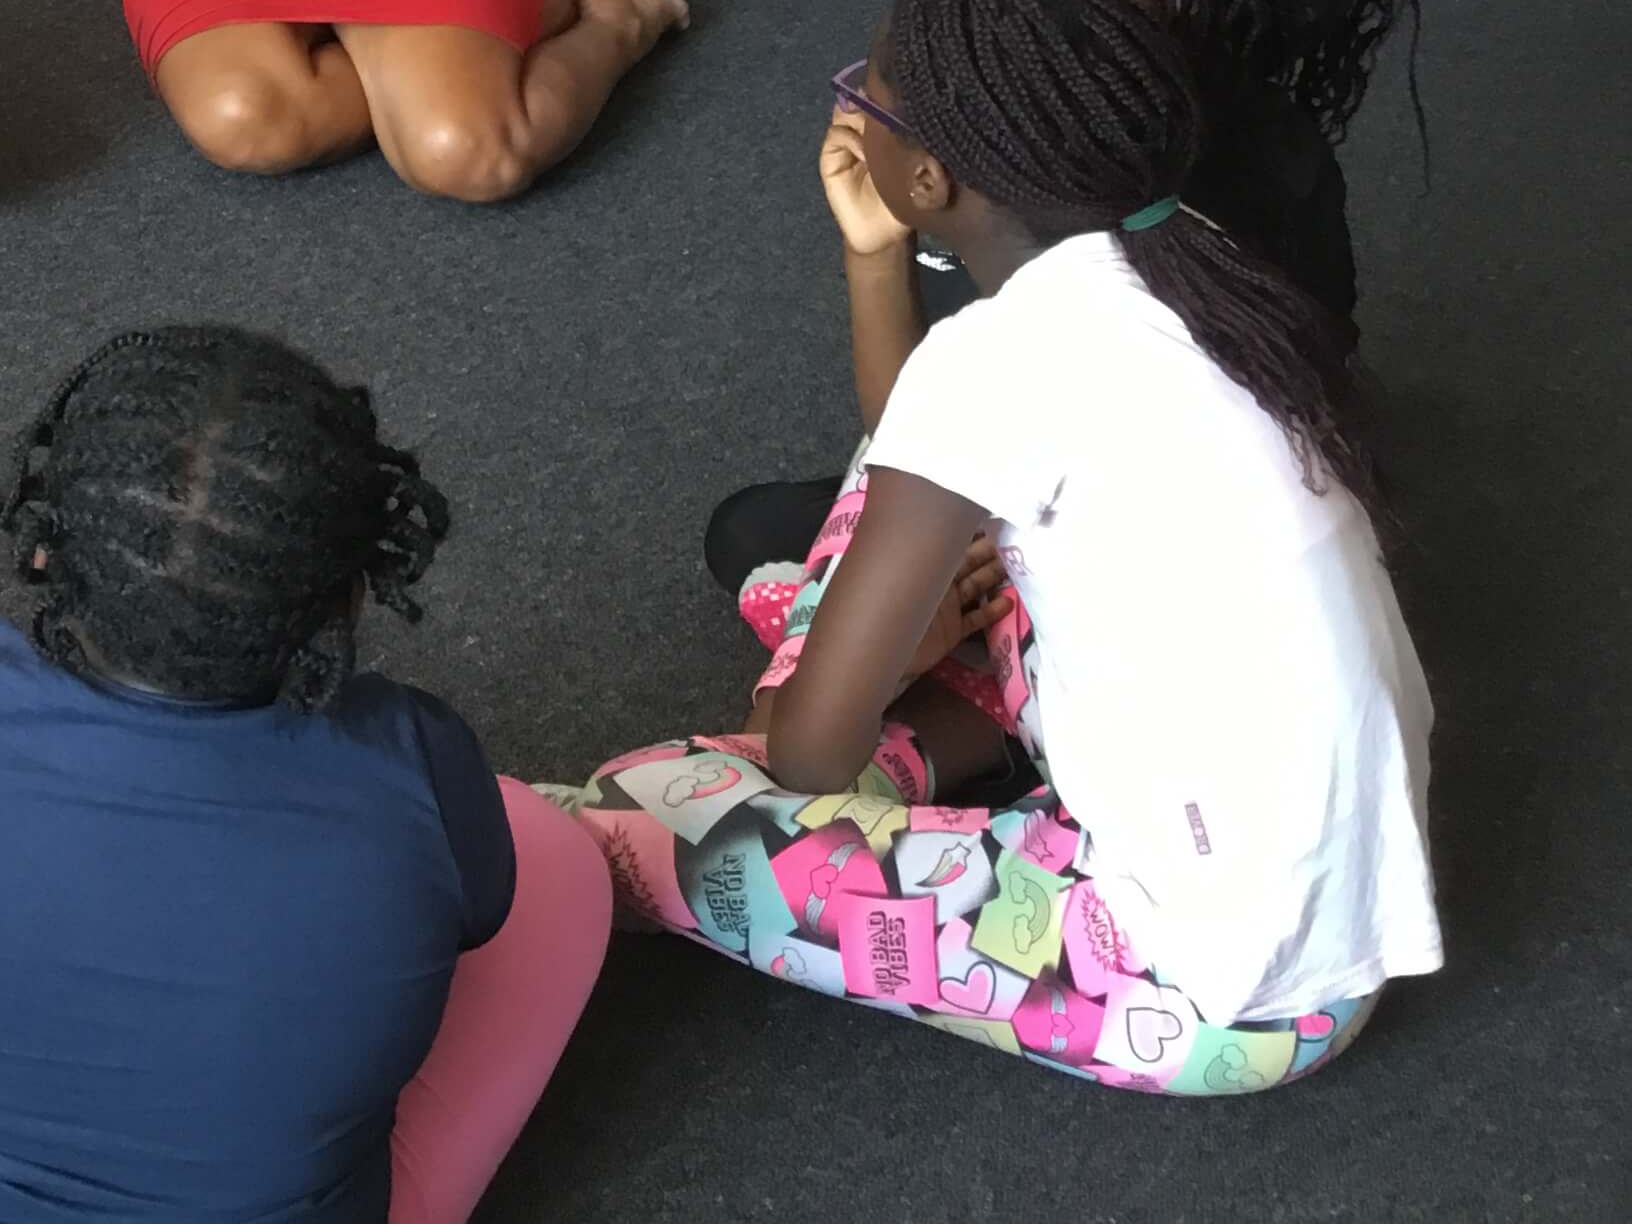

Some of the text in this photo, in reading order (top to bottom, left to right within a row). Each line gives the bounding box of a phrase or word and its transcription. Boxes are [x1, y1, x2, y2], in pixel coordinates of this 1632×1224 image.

[723, 853, 746, 891] NO
[867, 910, 896, 995] NO BAD
[887, 917, 912, 987] VIBES
